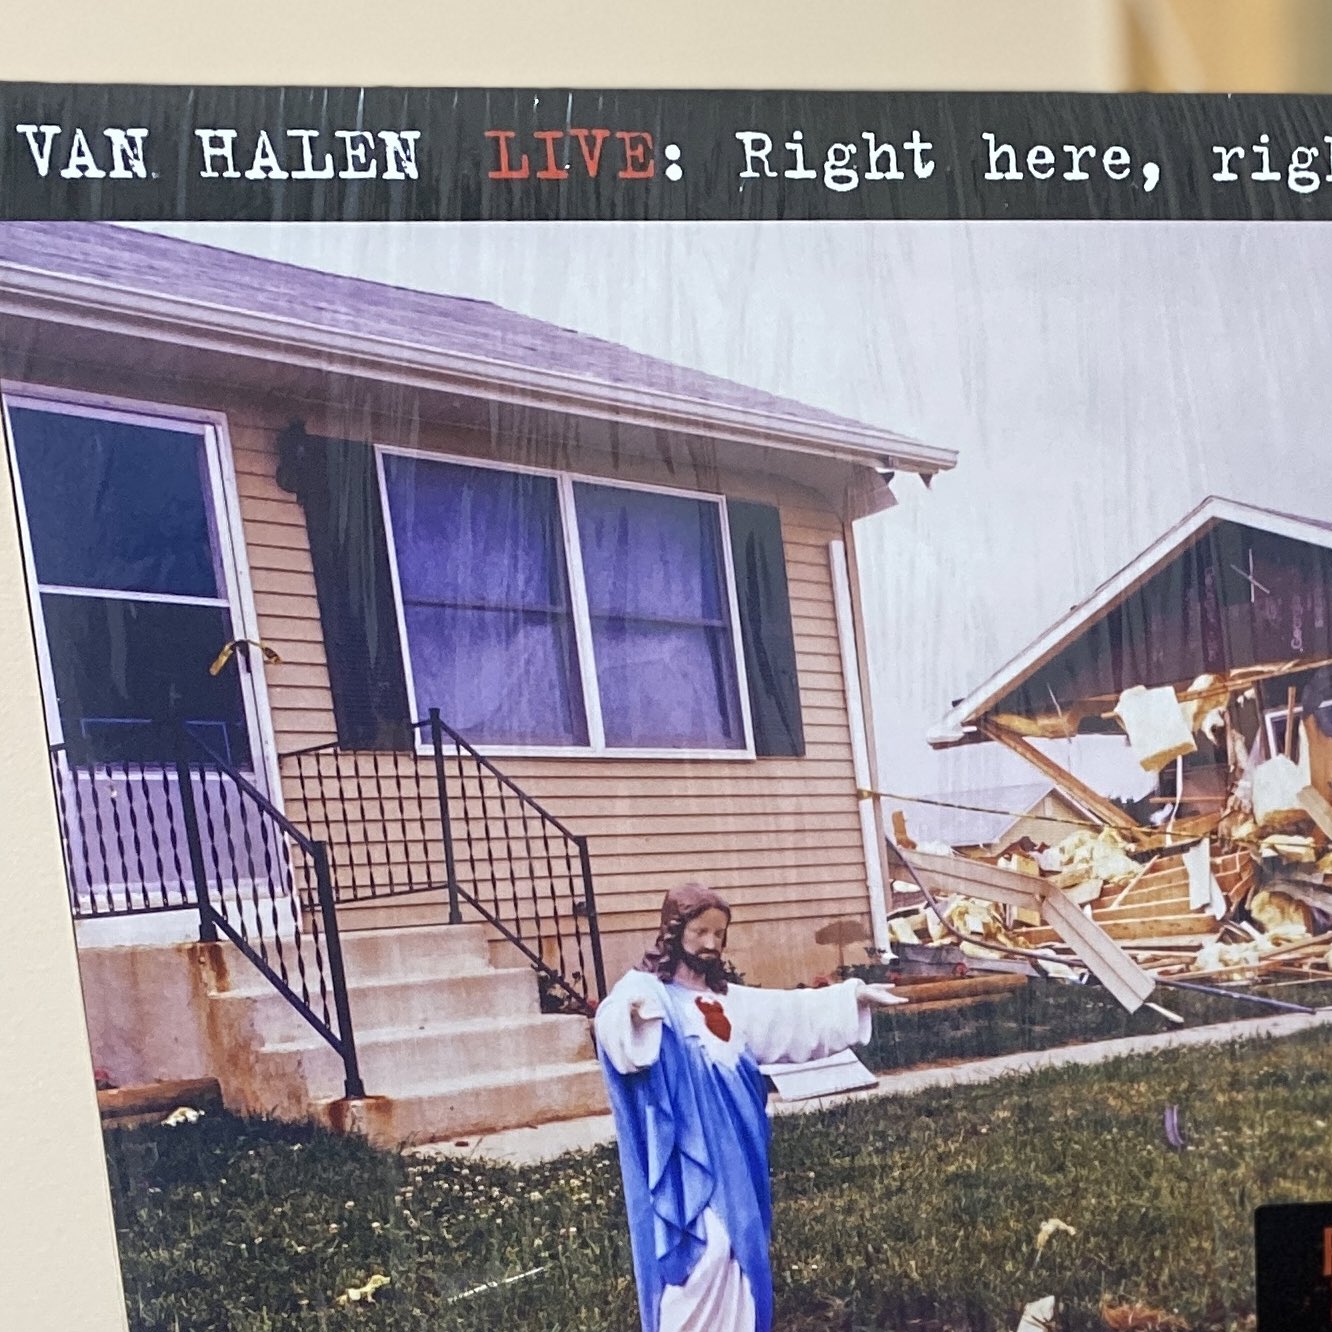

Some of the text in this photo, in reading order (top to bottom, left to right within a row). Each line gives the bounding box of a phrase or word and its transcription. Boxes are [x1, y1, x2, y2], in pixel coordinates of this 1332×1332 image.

[16, 124, 150, 180] VAN
[195, 128, 421, 180] HALEN
[484, 130, 683, 182] LIVE:
[735, 130, 936, 193] Right
[981, 132, 1160, 192] here,
